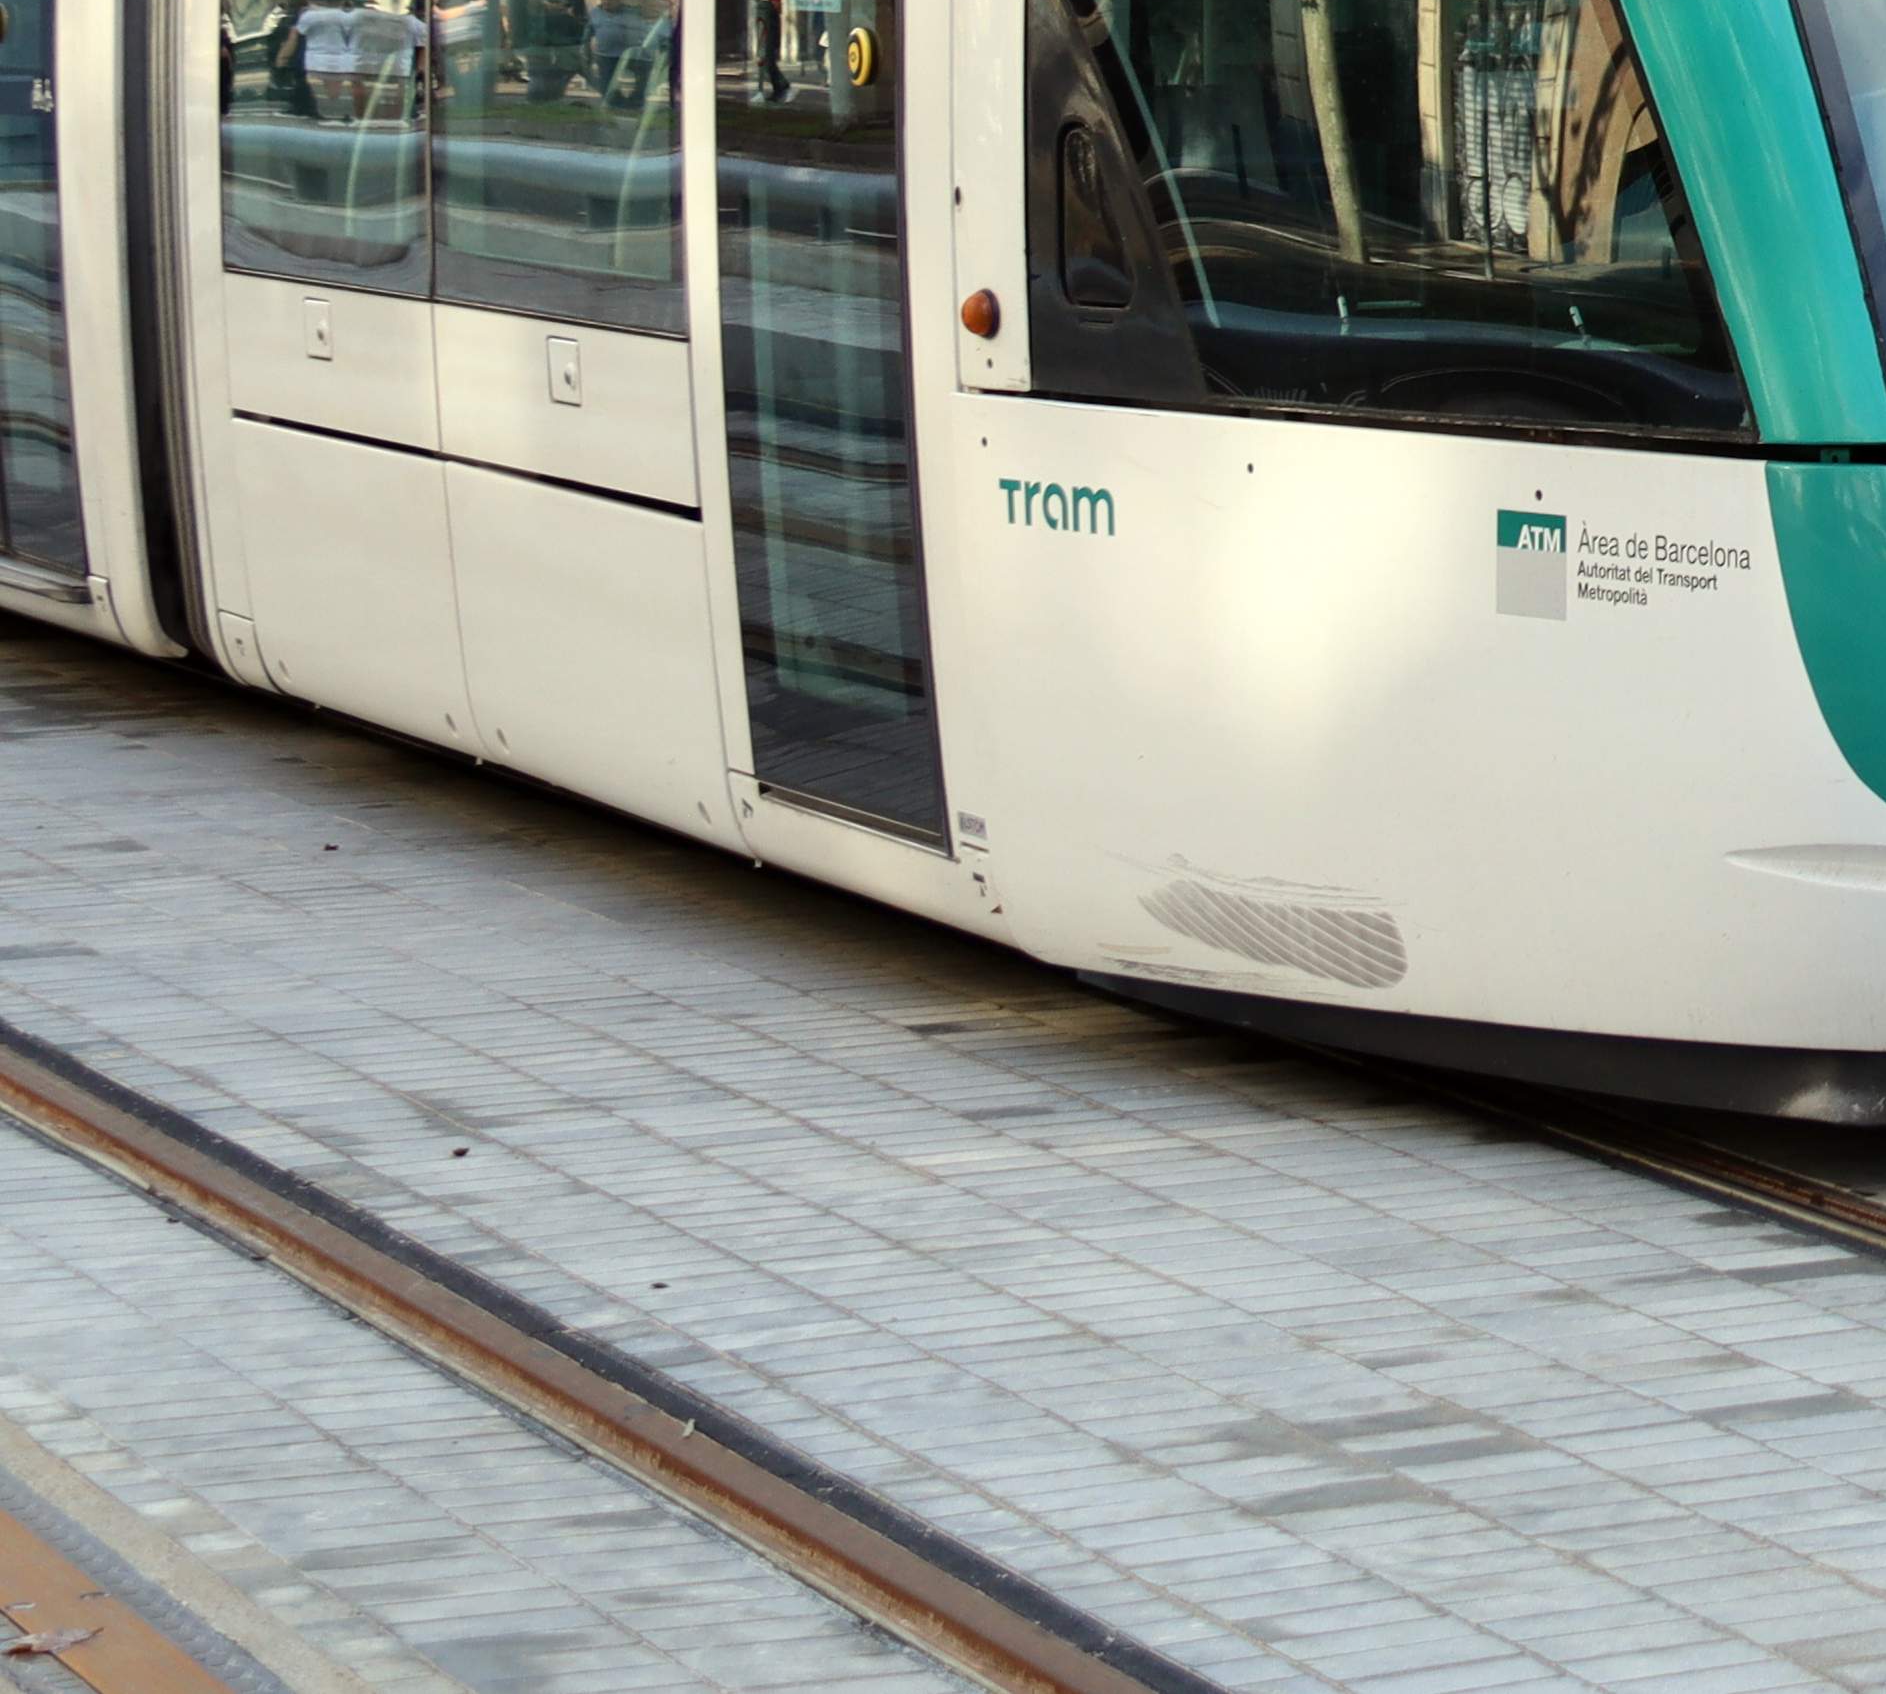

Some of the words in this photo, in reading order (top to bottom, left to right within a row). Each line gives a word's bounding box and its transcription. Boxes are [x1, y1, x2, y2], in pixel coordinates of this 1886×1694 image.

[1517, 524, 1562, 553] ATM
[1578, 520, 1620, 557] Àrea
[1625, 533, 1649, 560] de
[1655, 534, 1751, 570] Barcelona
[1577, 561, 1631, 583] Autoritat
[1634, 565, 1653, 584] del
[1657, 568, 1718, 592] Transport
[1577, 582, 1648, 606] Metropolità
